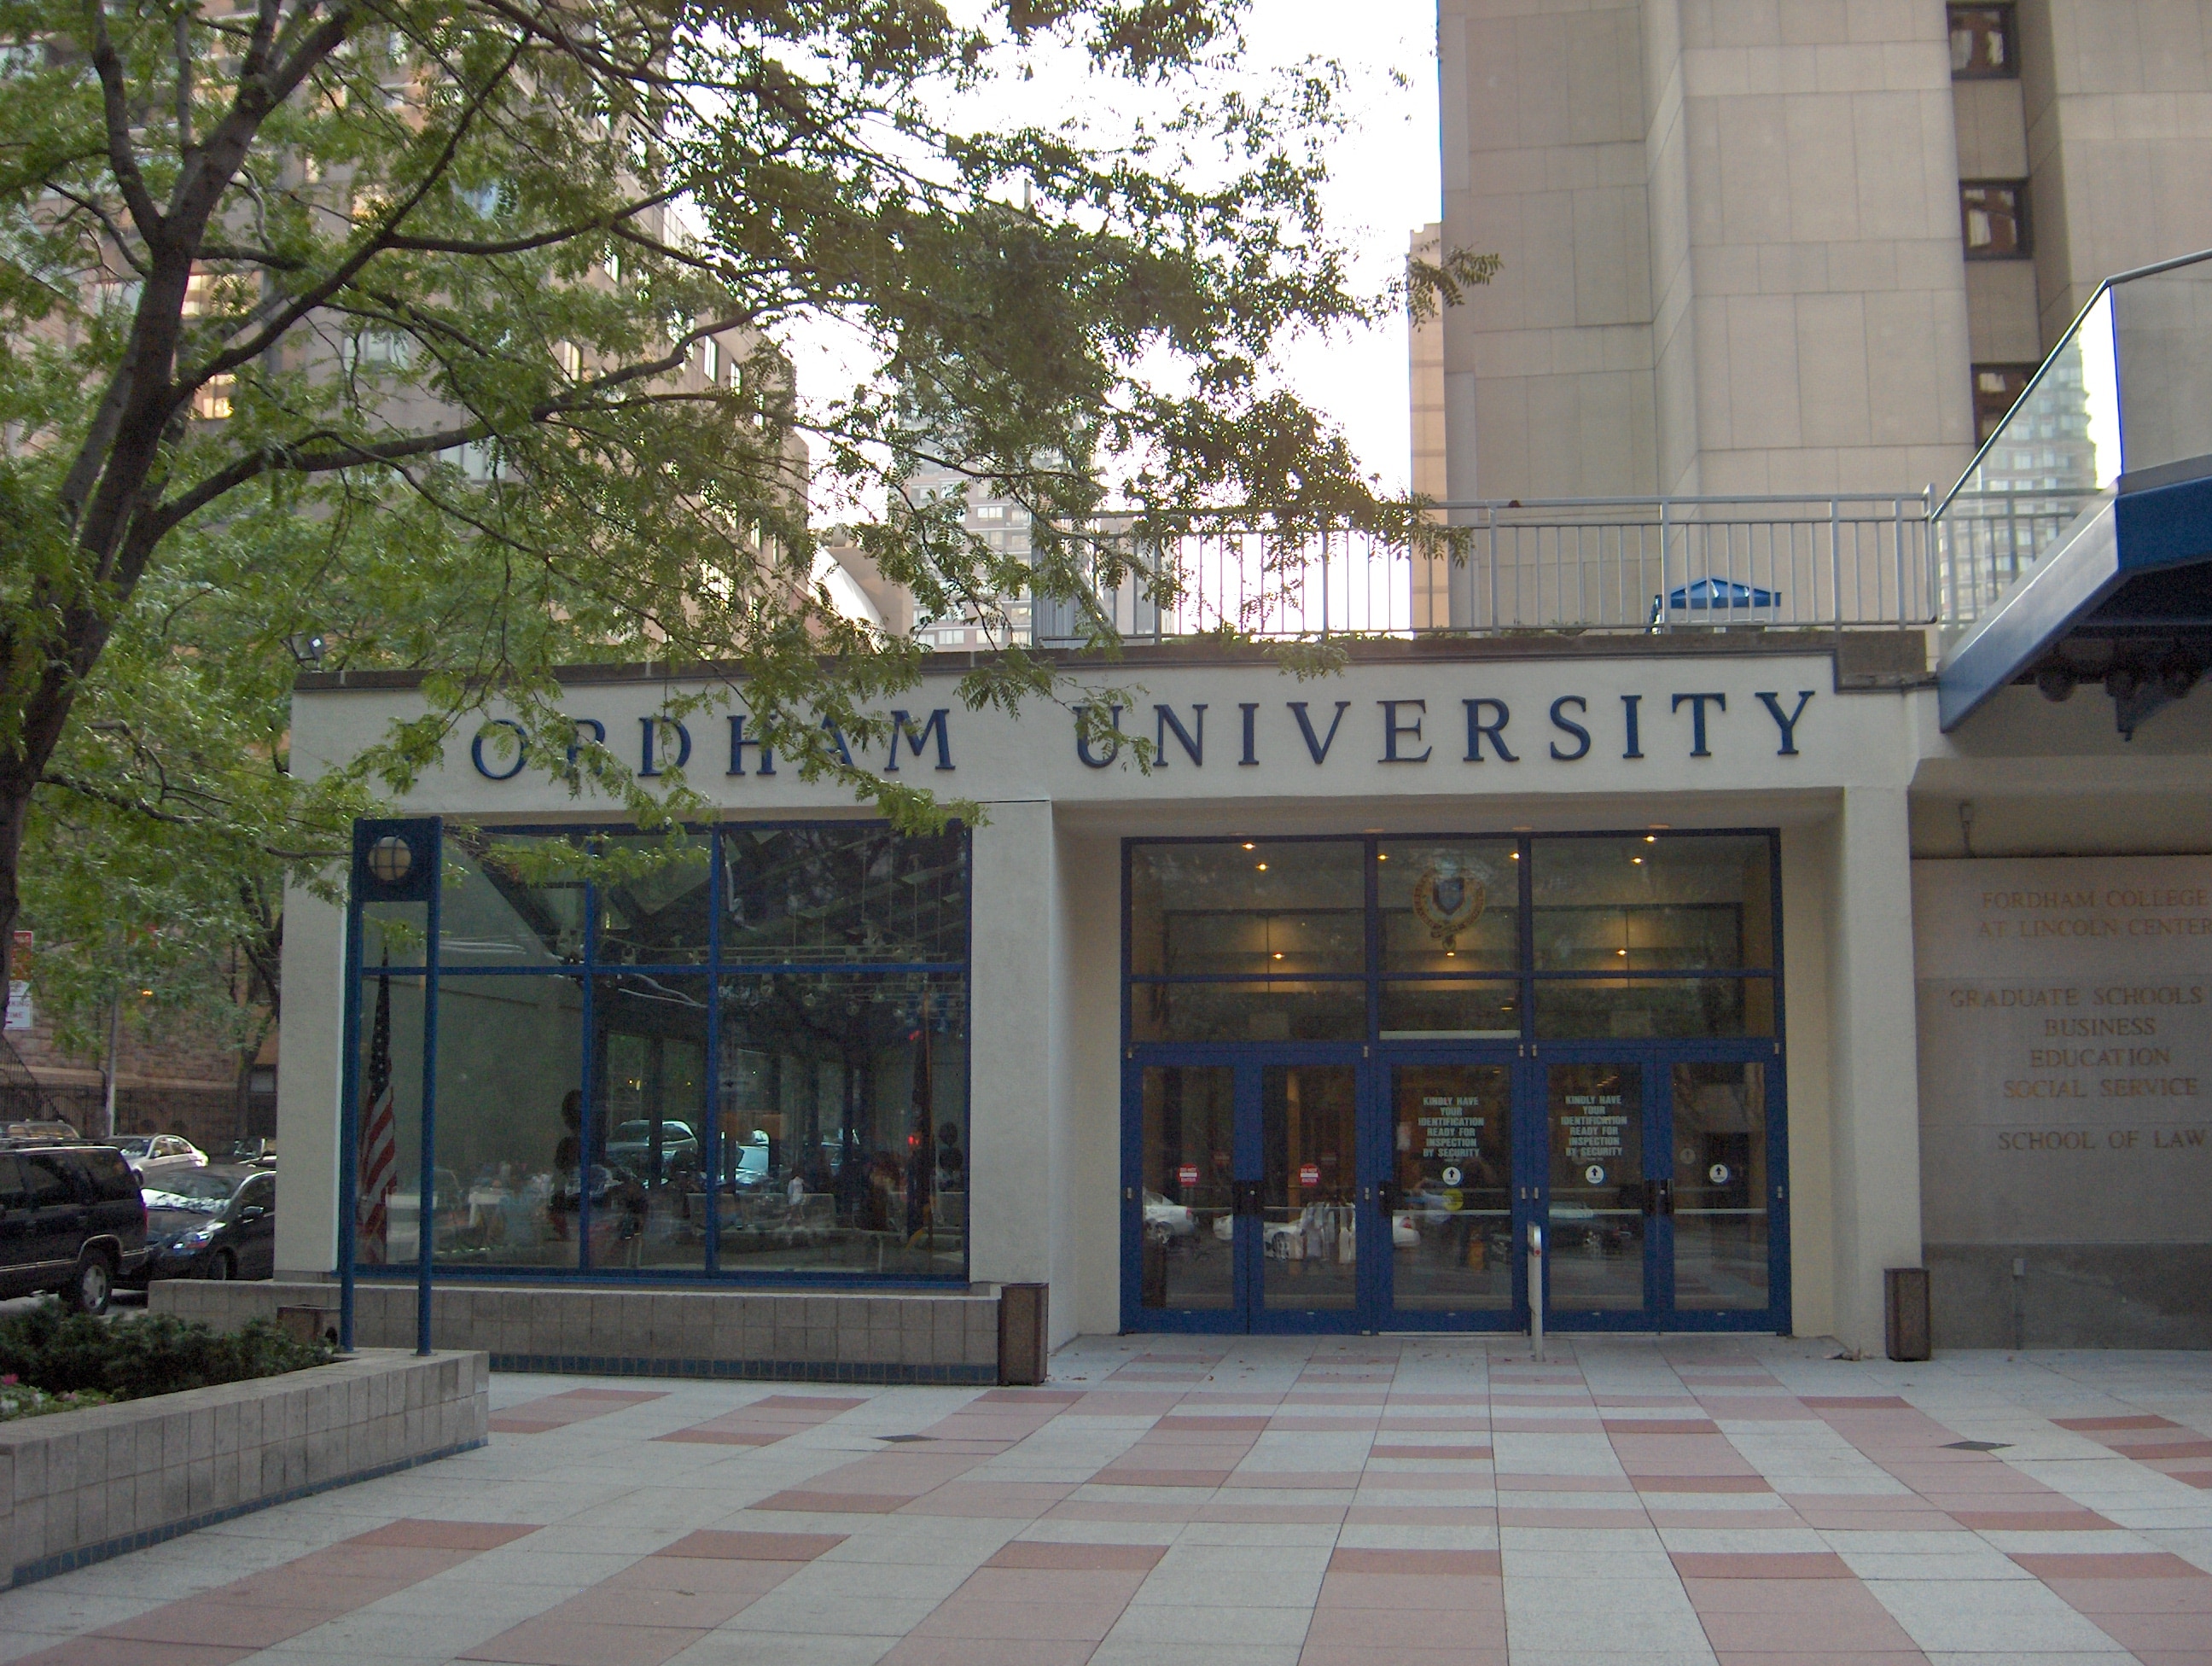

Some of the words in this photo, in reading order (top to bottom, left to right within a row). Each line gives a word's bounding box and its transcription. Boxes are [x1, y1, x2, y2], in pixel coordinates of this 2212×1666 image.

[397, 708, 956, 780] ORDHAM
[1073, 690, 1816, 769] UNIVERSITY
[1981, 891, 2094, 909] FORDHAM
[2105, 889, 2209, 907] COLLEGE
[1978, 920, 2005, 937] AT
[2019, 918, 2119, 937] LINCOLN
[2128, 917, 2212, 935] CENTER
[1950, 988, 2080, 1007] GRADUATE
[2093, 986, 2203, 1006] SCHOOLS
[2045, 1017, 2156, 1037] BUSINESS
[2030, 1047, 2172, 1068] EDUCATION
[2004, 1079, 2087, 1099] SOCIAL
[2100, 1077, 2199, 1098] SERVICE
[1423, 1097, 1453, 1106] KINDLY
[1456, 1097, 1479, 1106] HAVE
[1565, 1095, 1596, 1104] KINDLY
[1598, 1095, 1622, 1104] HAVE
[1440, 1107, 1463, 1116] YOUR
[1582, 1105, 1606, 1115] YOUR
[1417, 1116, 1485, 1127] IDENTIFICATION
[1560, 1116, 1628, 1126] IDENTIFICATION
[1426, 1127, 1456, 1137] READY
[1458, 1127, 1476, 1137] FOR
[1569, 1127, 1598, 1136] READY
[1601, 1127, 1619, 1136] FOR
[1425, 1138, 1477, 1147] INSPECTION
[1569, 1137, 1620, 1146] INSPECTION
[1998, 1131, 2096, 1150] SCHOOL
[2108, 1130, 2139, 1149] OF
[2154, 1129, 2206, 1149] LAW
[1423, 1148, 1435, 1157] BY
[1437, 1148, 1480, 1157] SECURITY
[1565, 1147, 1578, 1156] BY
[1580, 1147, 1622, 1156] SECURITY
